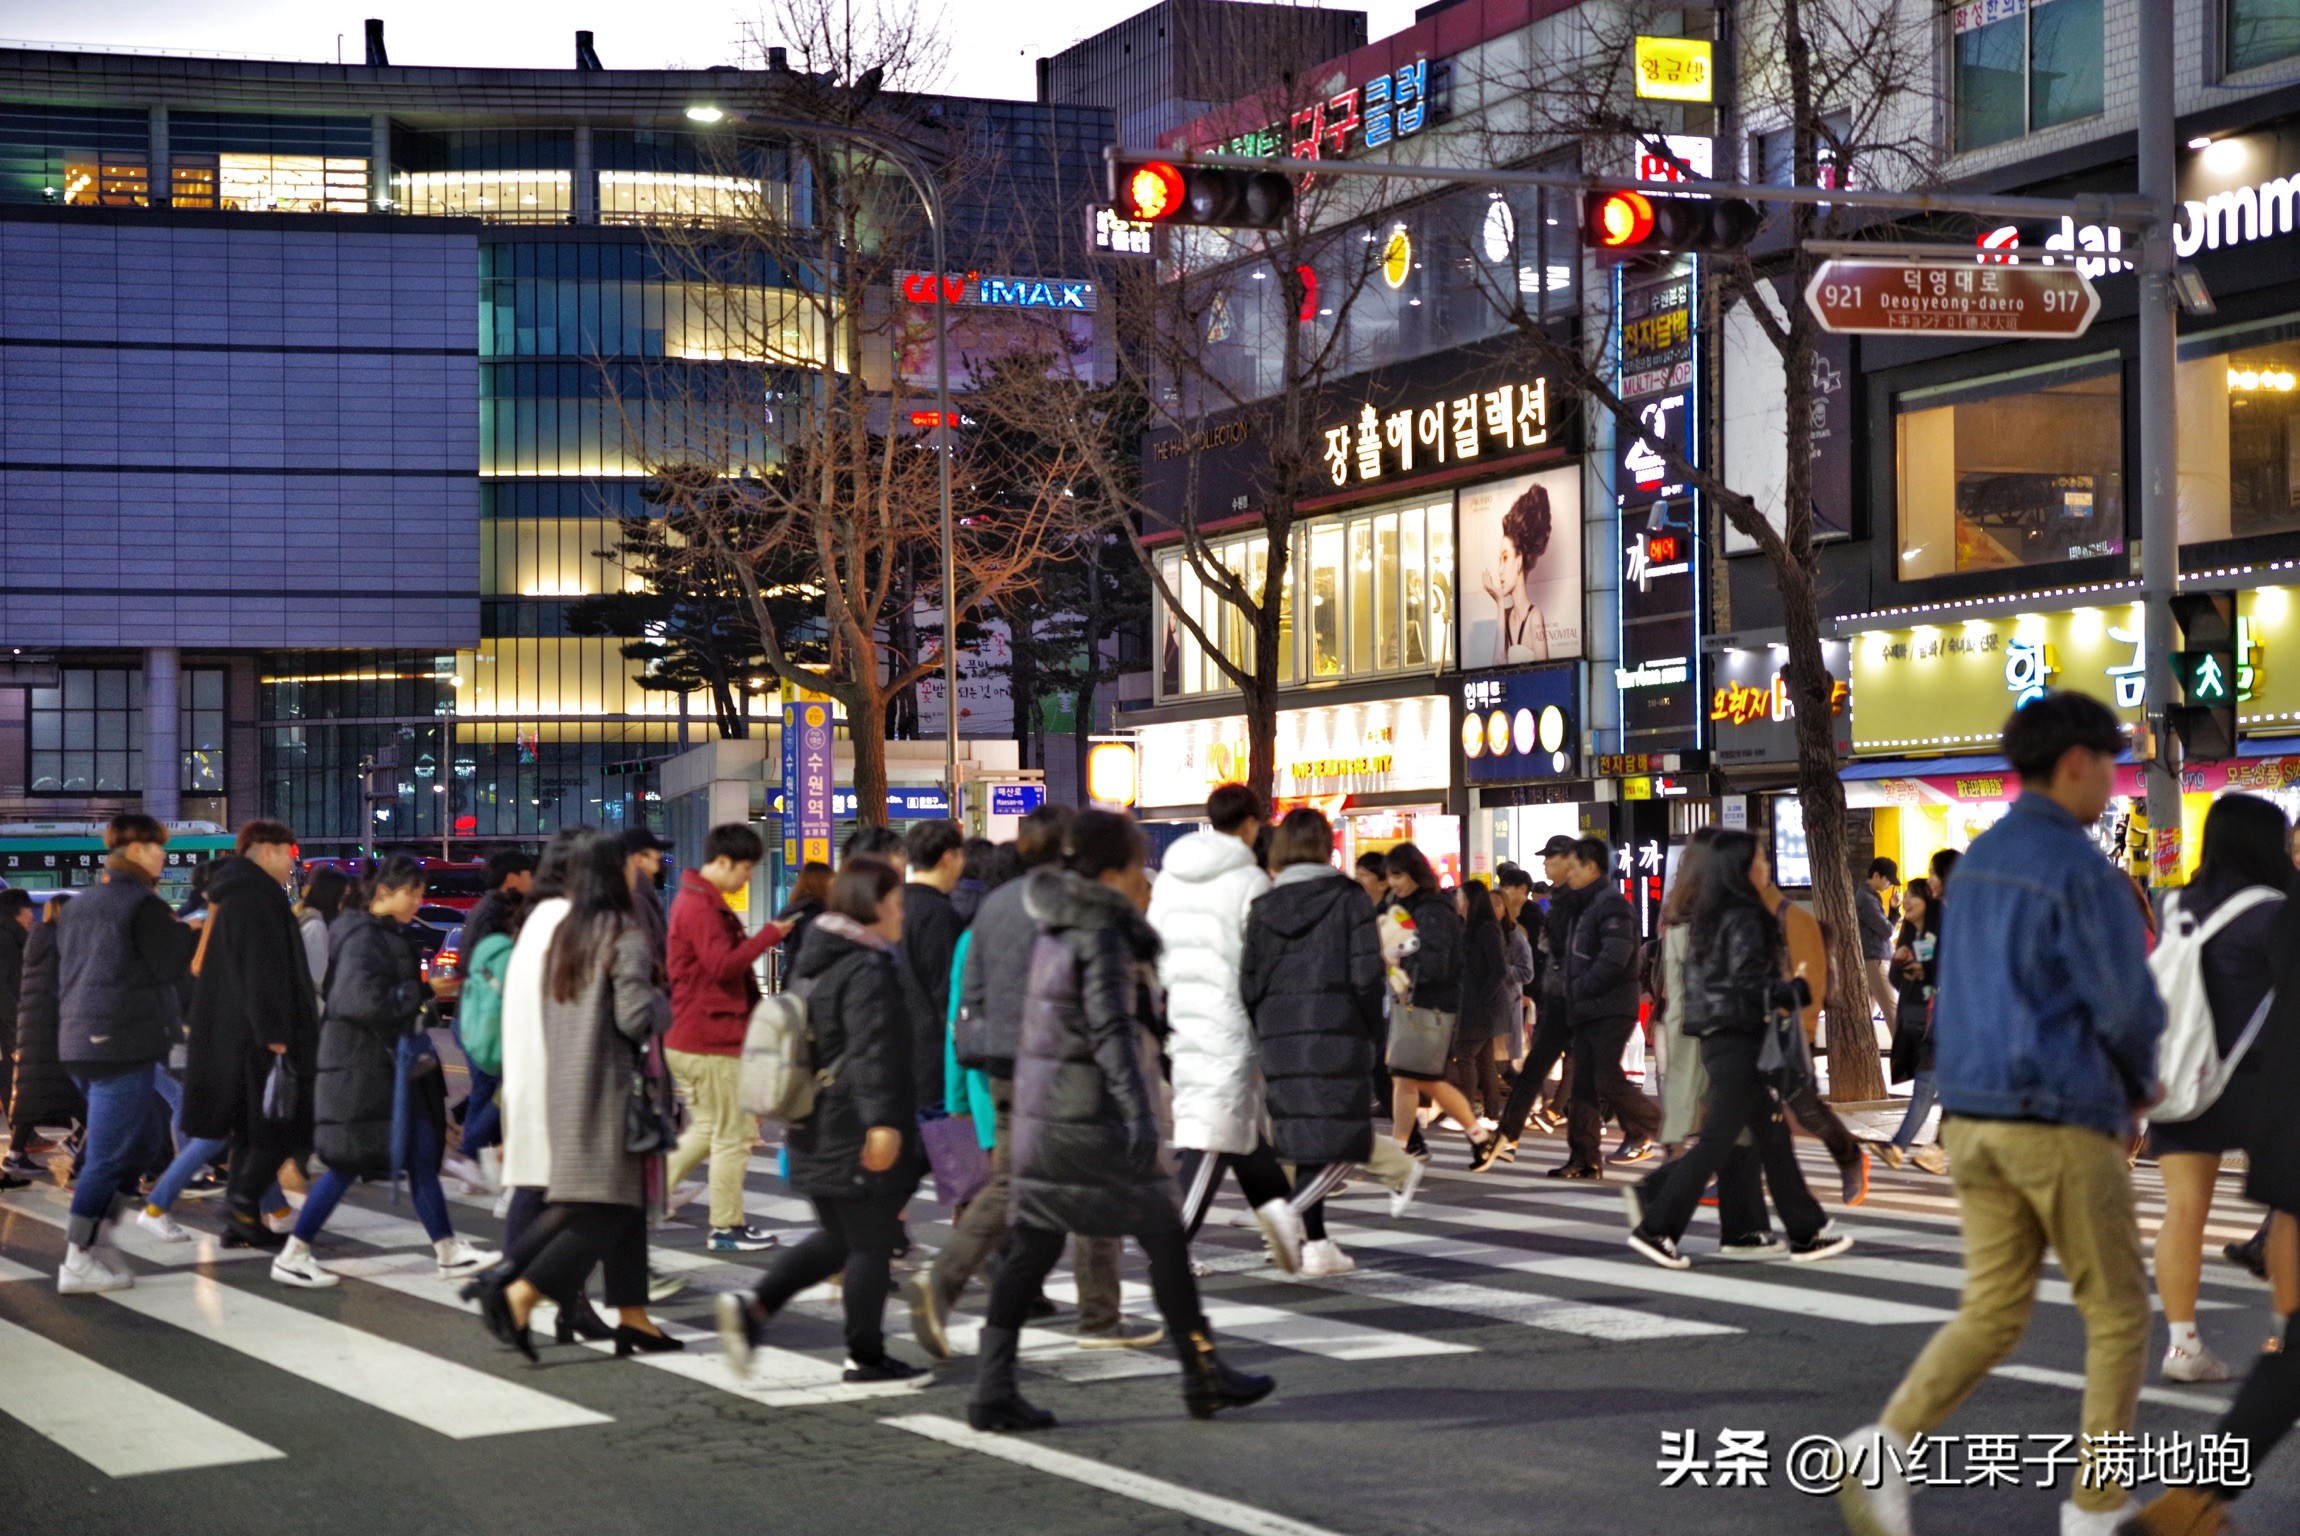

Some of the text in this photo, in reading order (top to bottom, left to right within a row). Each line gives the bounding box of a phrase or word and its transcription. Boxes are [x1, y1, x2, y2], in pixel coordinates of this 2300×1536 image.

[979, 279, 1086, 309] IMAX
[1903, 270, 1999, 297] 덕영대로
[1825, 284, 2080, 313] 921 Deogyeong-daero 917
[1153, 440, 1168, 462] THE
[807, 752, 824, 820] 수원역
[2226, 763, 2280, 785] 모든상품
[812, 841, 820, 855] 8
